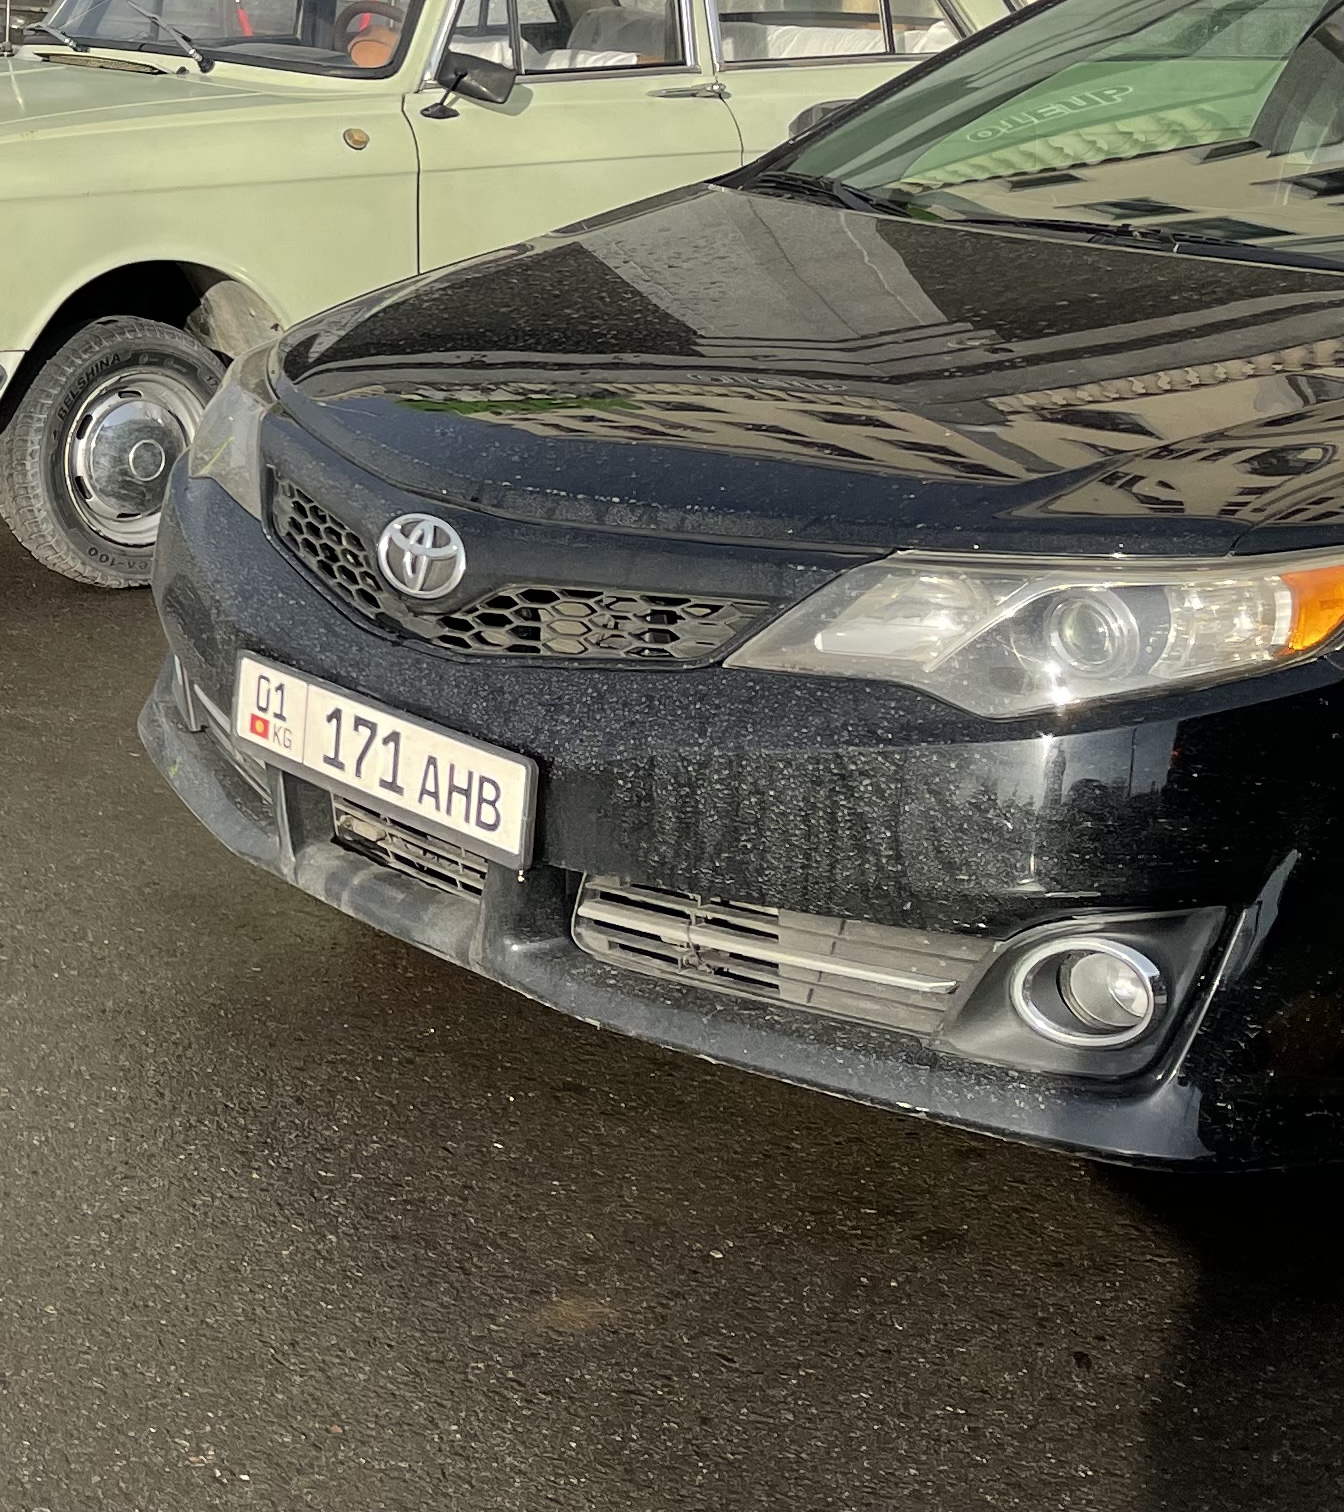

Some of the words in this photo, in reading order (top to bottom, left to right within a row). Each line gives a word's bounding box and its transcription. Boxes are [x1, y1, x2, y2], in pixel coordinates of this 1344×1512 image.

[57, 352, 121, 422] BELSHINA
[256, 674, 287, 723] 01
[322, 707, 405, 796] 171
[418, 755, 502, 832] AHB
[272, 723, 293, 751] KG
